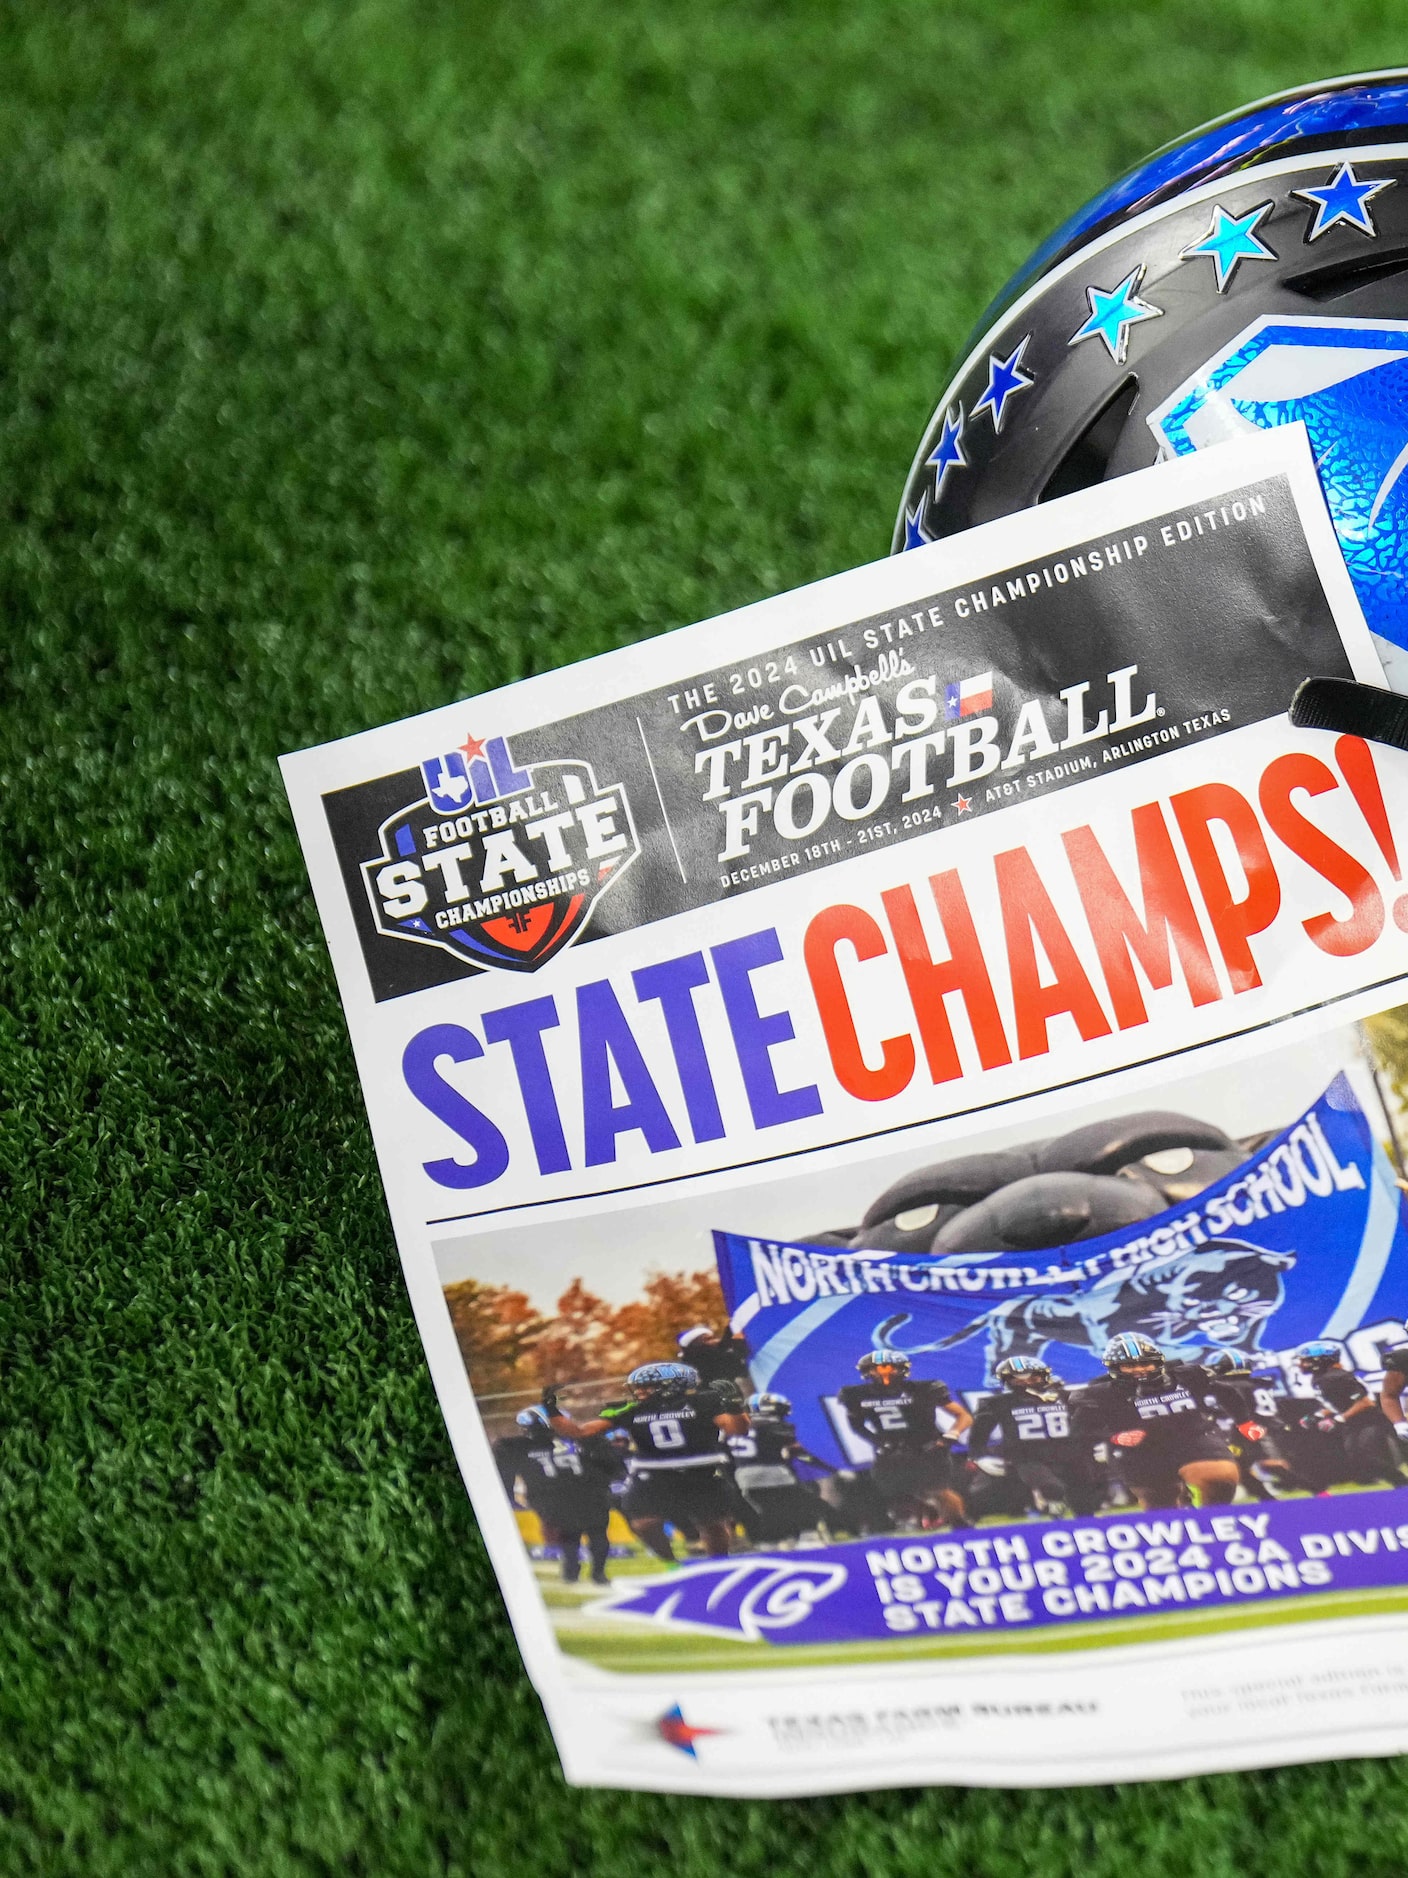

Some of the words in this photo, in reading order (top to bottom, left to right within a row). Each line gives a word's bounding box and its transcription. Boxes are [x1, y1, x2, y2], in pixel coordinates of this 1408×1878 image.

[667, 683, 718, 713] THE
[729, 656, 798, 695] 2024
[810, 639, 852, 667] UIL
[864, 607, 944, 649] STATE
[954, 535, 1149, 618] CHAMPIONSHIP
[1160, 495, 1266, 547] EDITION
[679, 704, 774, 742] Dave
[779, 648, 915, 715] Campbell's
[694, 674, 937, 801] TEXAS
[422, 791, 559, 849] FOOTBALL
[720, 853, 800, 888] DECEMBER
[804, 838, 841, 862] 18TH
[857, 821, 899, 845] 21ST,
[902, 805, 942, 829] 2024
[985, 779, 1021, 802] AT&T
[1026, 757, 1098, 788] STADIUM,
[1102, 726, 1180, 763] ARLINGTON
[1183, 708, 1231, 735] TEXAS
[375, 796, 628, 920] STATE
[435, 869, 590, 930] CHAMPIONSHIPS
[400, 927, 824, 1190] STATE
[748, 1239, 898, 1307] NORTH
[1205, 1111, 1368, 1235] SCHOOL
[649, 1418, 685, 1449] 0
[874, 1406, 909, 1430] 2
[1014, 1411, 1070, 1440] 28
[1134, 1397, 1158, 1408] NORTH
[865, 1535, 1030, 1577] NORTH
[1042, 1513, 1271, 1558] CROWLEY
[874, 1573, 927, 1604] IS
[935, 1558, 1069, 1598] YOUR
[1080, 1545, 1211, 1583] 2024
[1224, 1538, 1293, 1567] 6A
[883, 1591, 1034, 1632] STATE
[1042, 1559, 1333, 1617] CHAMPIONS
